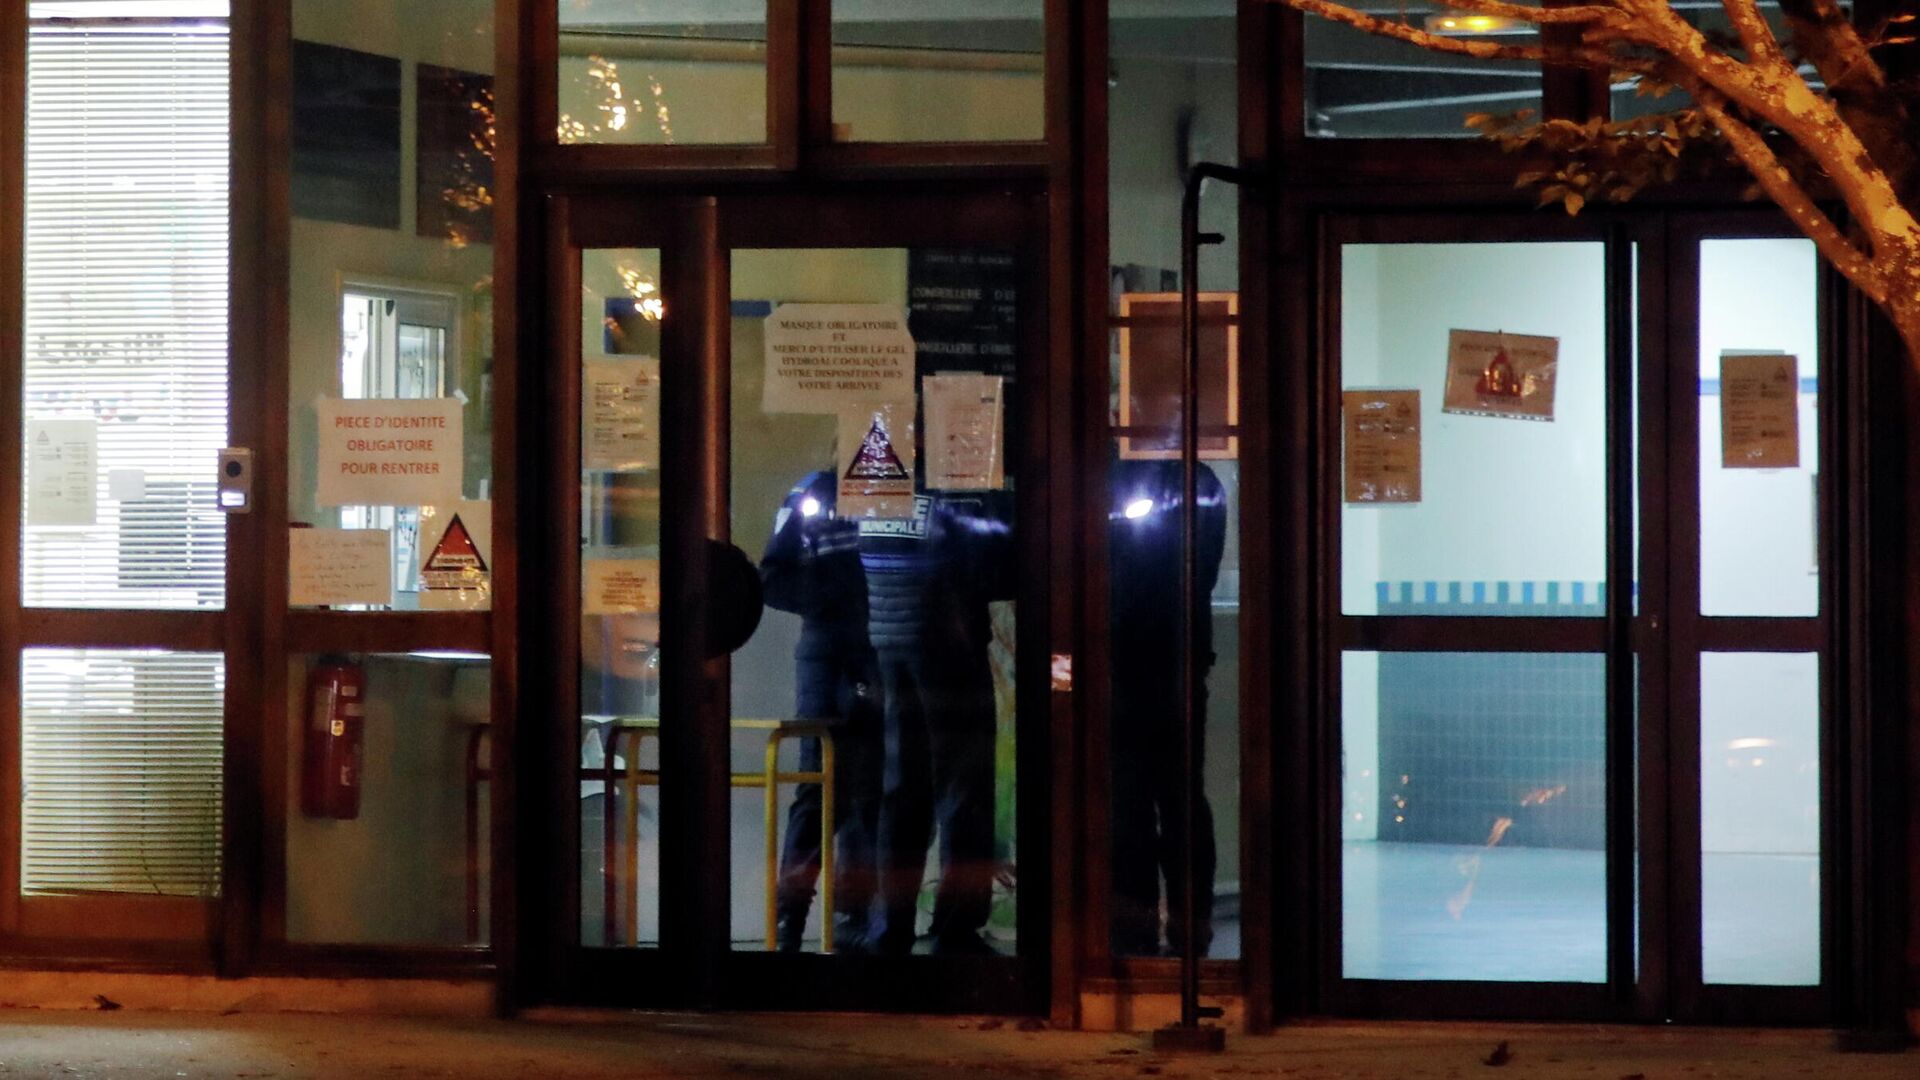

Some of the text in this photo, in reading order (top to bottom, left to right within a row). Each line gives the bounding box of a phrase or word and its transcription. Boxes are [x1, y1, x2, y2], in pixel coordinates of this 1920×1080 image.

[780, 321, 898, 330] MASQUE OBLIGATOIRE
[832, 333, 845, 341] ET
[774, 344, 806, 353] MERCI
[870, 345, 882, 354] LE
[886, 345, 907, 354] GEL
[782, 357, 888, 367] HYDROALCOOLIQUE
[778, 369, 812, 378] VOTRE
[815, 369, 880, 378] DISPOSITION
[798, 381, 881, 390] VOTRE ARRIVEE
[335, 416, 446, 428] PIECE D'IDENTITE
[347, 440, 433, 452] OBLIGATOIRE
[341, 462, 440, 474] POUR RENTRER
[860, 520, 926, 536] MUNICIPALE
